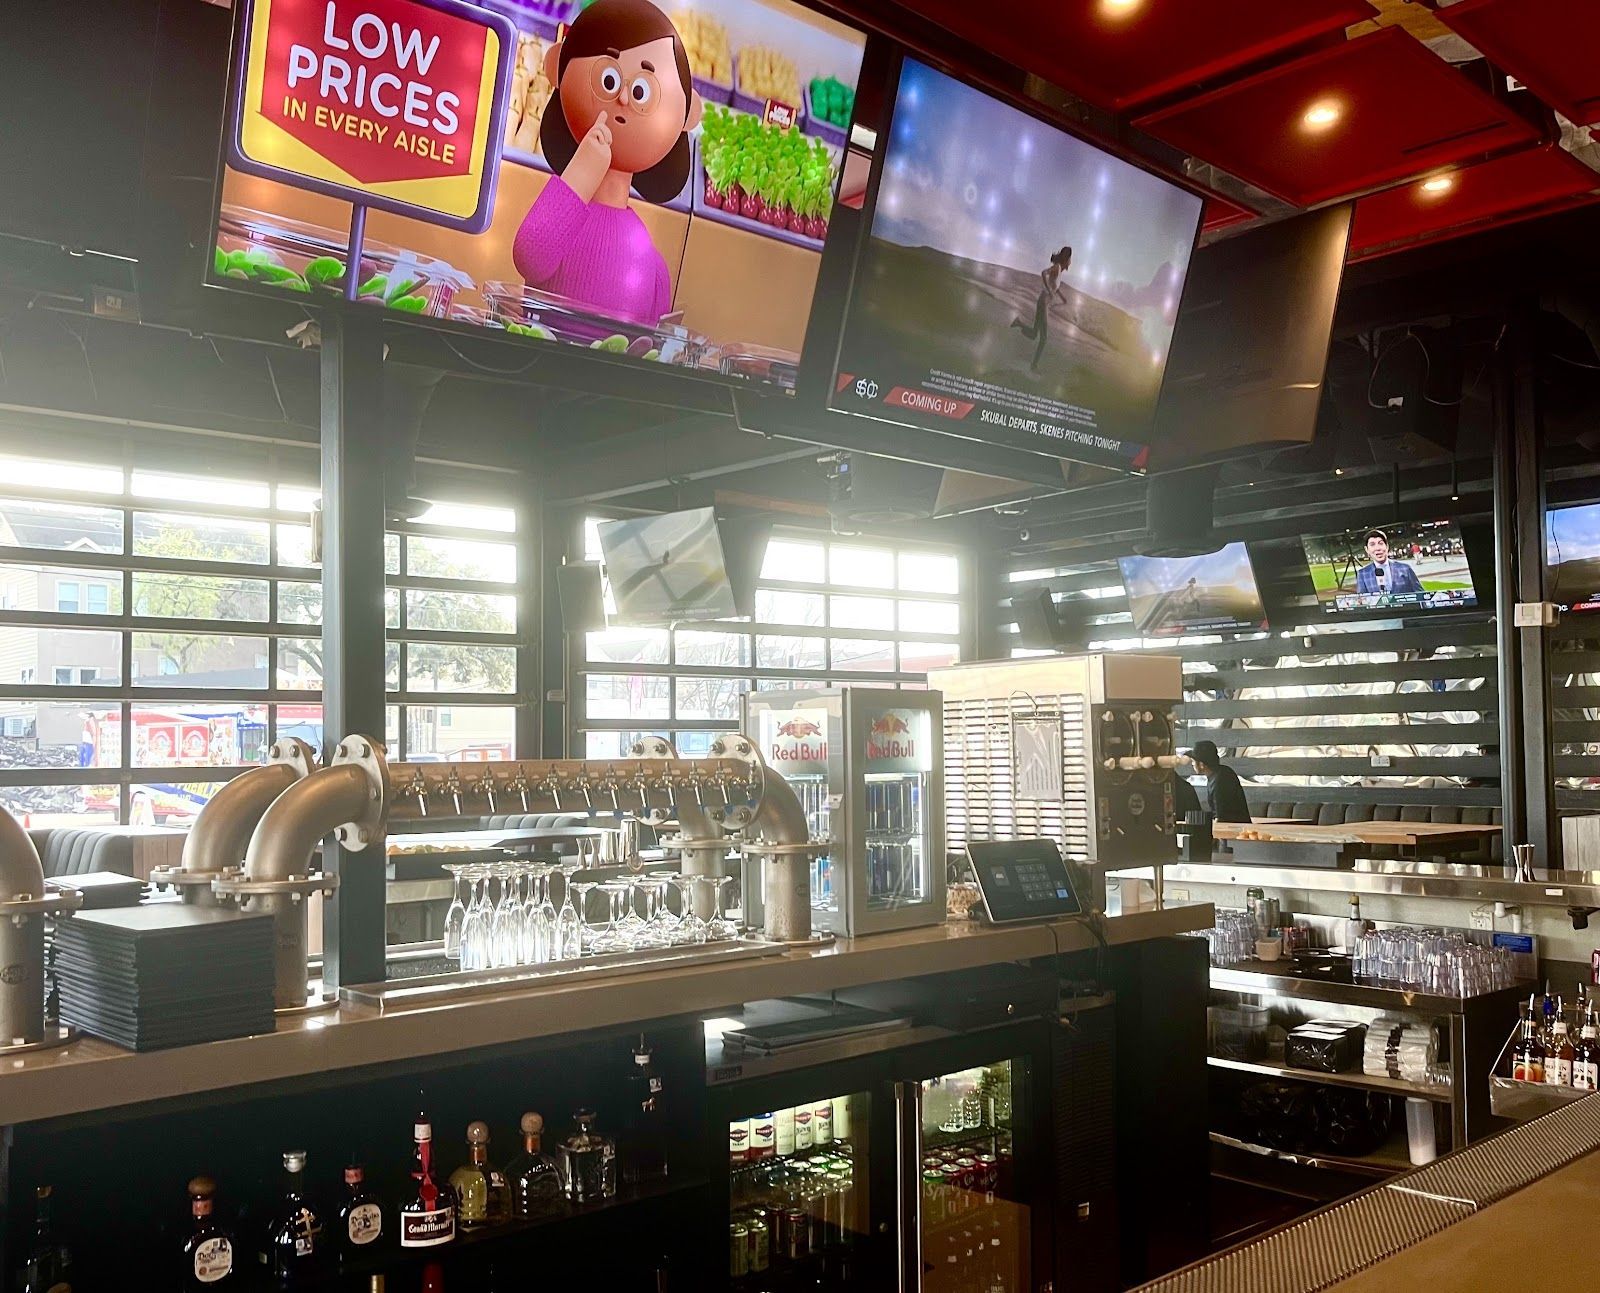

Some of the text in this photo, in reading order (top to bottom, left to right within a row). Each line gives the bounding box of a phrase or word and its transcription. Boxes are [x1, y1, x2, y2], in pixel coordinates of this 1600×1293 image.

[323, 1, 440, 76] LOW
[287, 44, 460, 135] PRICES
[283, 95, 456, 165] IN EVERY AISLE
[901, 391, 957, 414] COMING UP
[980, 409, 1121, 451] SKUBAL DEPARTS, SKENES PITCHING TONIGHT
[772, 742, 827, 760] Red Bull
[892, 739, 914, 758] Bull
